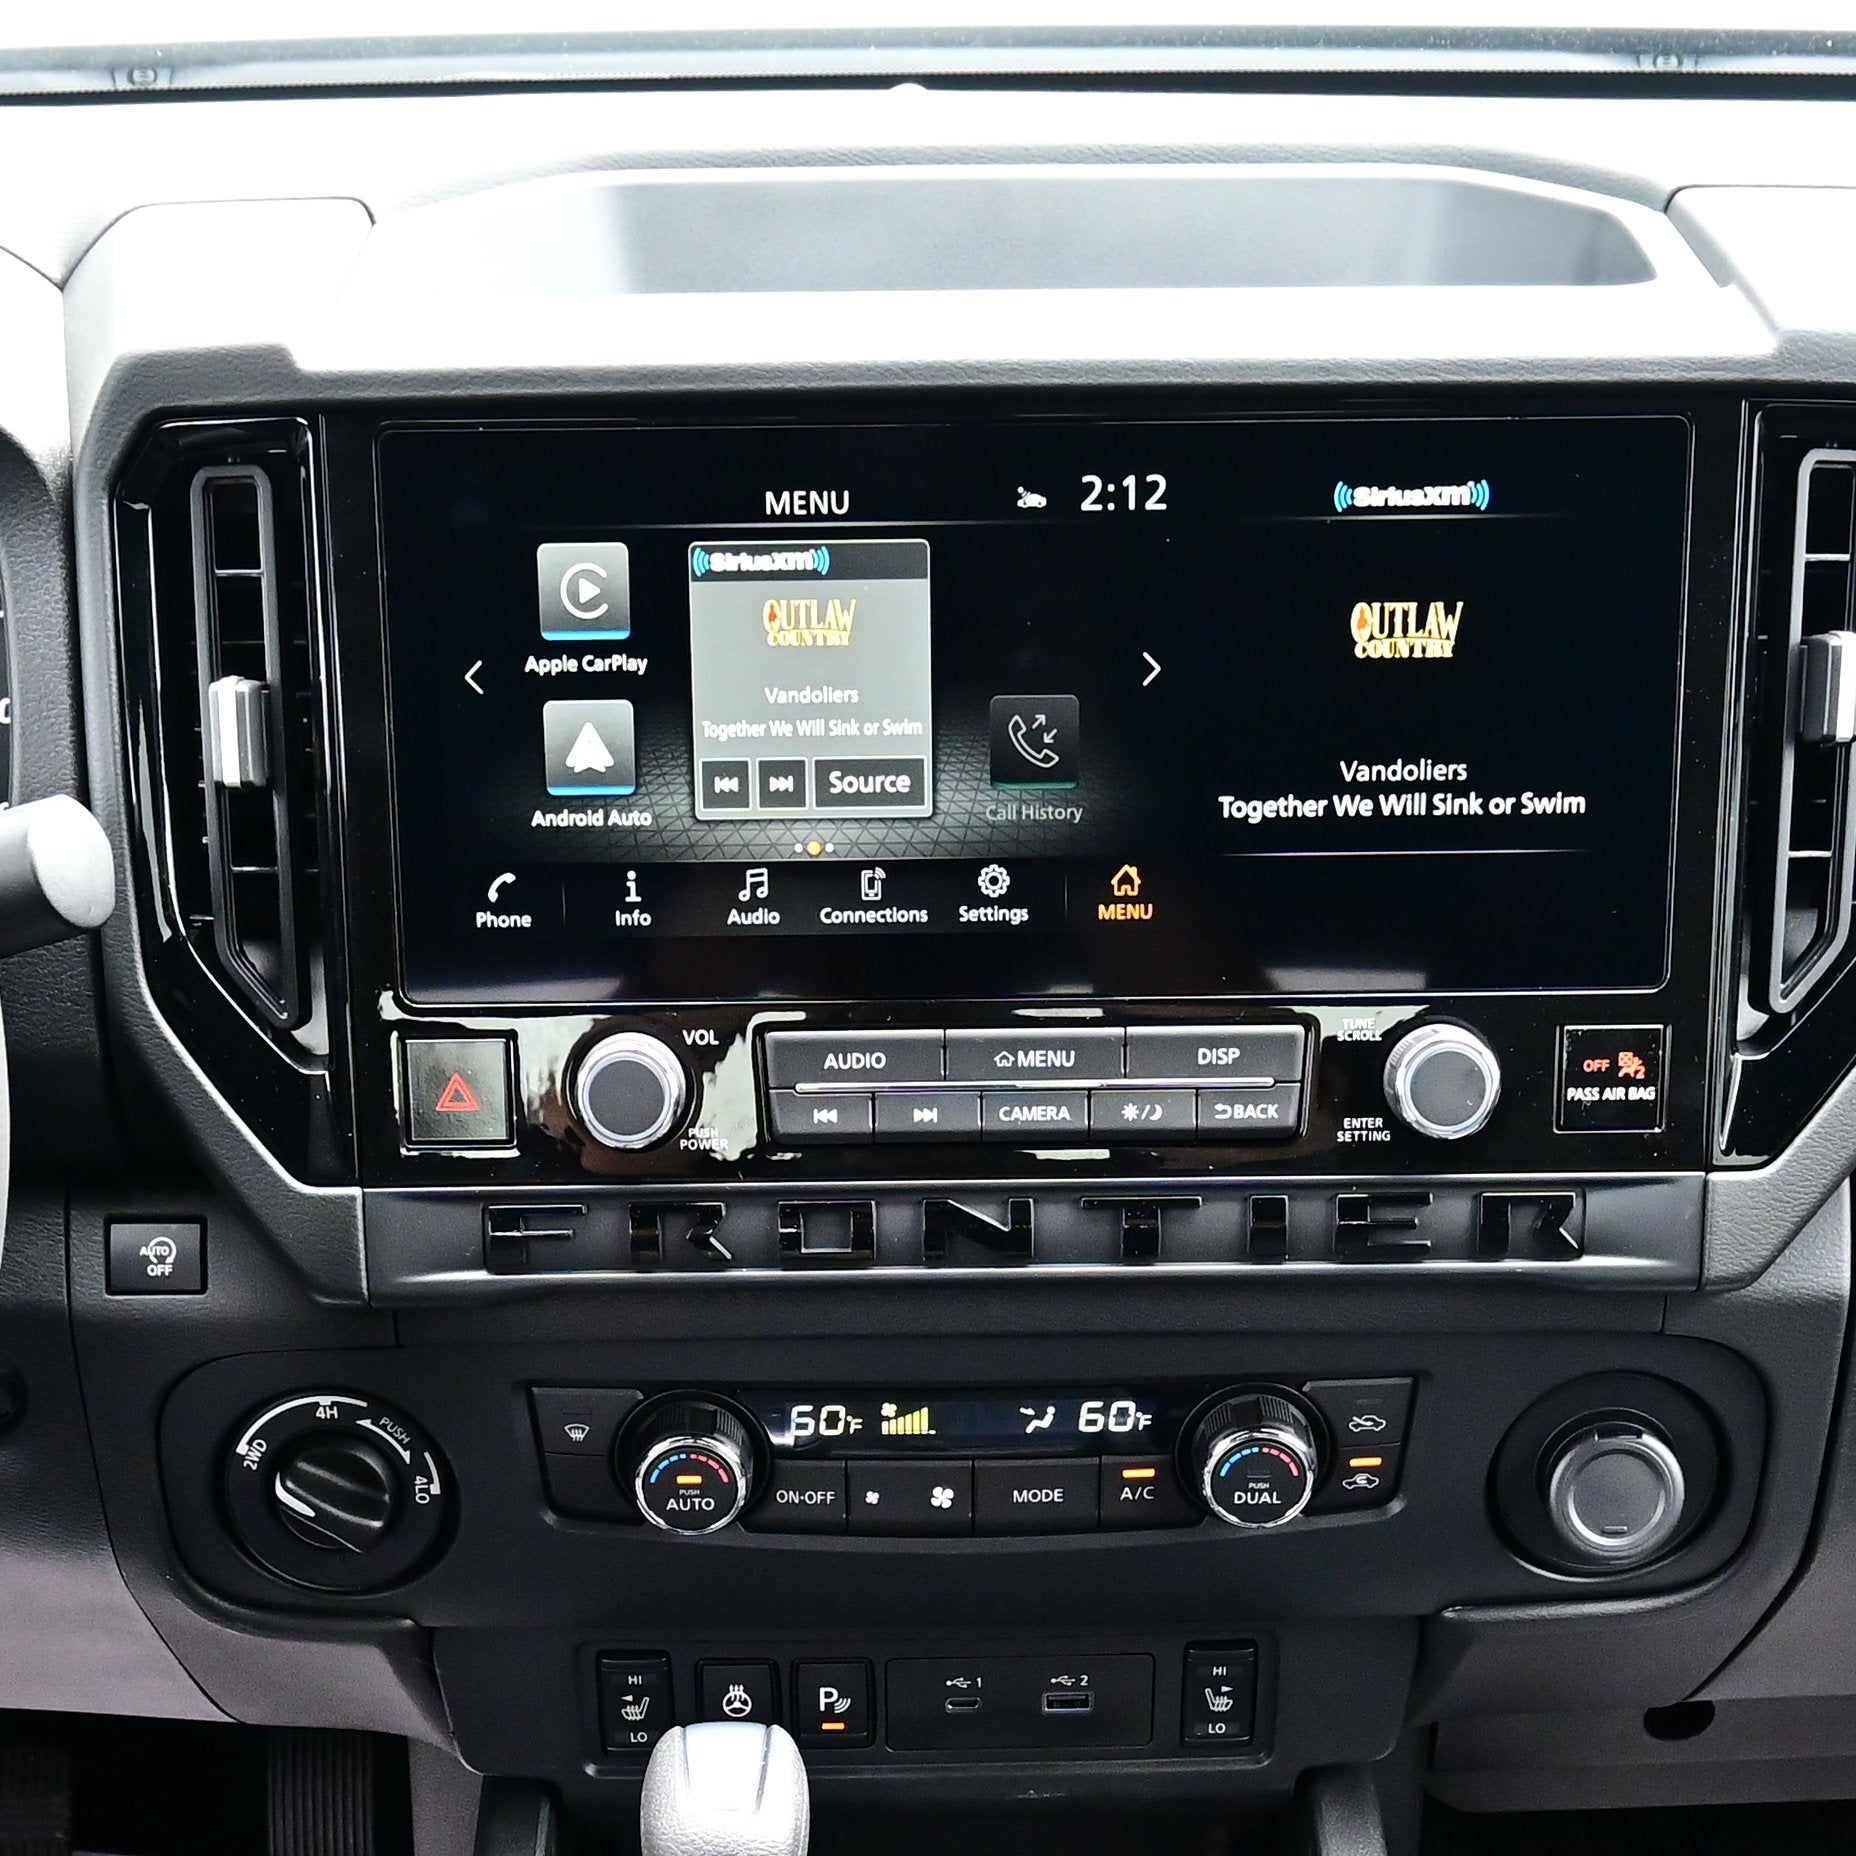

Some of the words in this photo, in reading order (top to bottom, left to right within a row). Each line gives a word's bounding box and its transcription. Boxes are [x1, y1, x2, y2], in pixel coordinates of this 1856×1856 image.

[1080, 474, 1168, 512] 2:12
[765, 490, 850, 515] MENU
[763, 598, 857, 632] OUTLAW
[1350, 601, 1464, 640] OUTLAW
[767, 630, 852, 647] COUNTRY
[1354, 638, 1455, 659] COUNTRY
[524, 654, 578, 676] Apple
[581, 654, 648, 675] CarPlay
[764, 686, 859, 704] Vandoliers
[702, 720, 766, 740] Together
[768, 720, 793, 737] We
[796, 719, 825, 737] Will
[828, 718, 860, 736] Sink
[863, 722, 879, 736] or
[882, 719, 924, 736] Swim
[1339, 760, 1468, 783] Vandoliers
[829, 770, 911, 793] Source
[985, 804, 1015, 821] Call
[1022, 803, 1083, 825] History
[1218, 796, 1328, 824] Together
[1332, 795, 1373, 818] We
[1379, 794, 1427, 817] Will
[1432, 793, 1484, 817] Sink
[1489, 799, 1516, 816] or
[1520, 792, 1587, 816] Swim
[531, 809, 604, 827] Android
[607, 809, 653, 826] Auto
[475, 909, 532, 929] Phone
[615, 908, 652, 928] Info
[727, 907, 781, 926] Audio
[819, 906, 929, 925] Connections
[958, 904, 1030, 926] Settings
[1097, 903, 1154, 922] MENU
[1342, 1018, 1376, 1031] TUNE
[682, 1029, 720, 1046] VOL
[1336, 1029, 1382, 1042] SCROLL
[824, 1052, 887, 1070] AUDIO
[1016, 1050, 1076, 1068] MENU
[1197, 1048, 1241, 1066] DISP
[1582, 1059, 1610, 1073] OFF
[1566, 1087, 1601, 1102] PASS
[1602, 1086, 1626, 1101] AIR
[1627, 1085, 1656, 1101] BAG
[999, 1105, 1070, 1122] CAMERA
[1234, 1103, 1280, 1120] BACK
[1343, 1117, 1384, 1130] ENTER
[688, 1127, 720, 1139] PUSH
[1336, 1129, 1391, 1143] SETTING
[679, 1138, 729, 1151] POWER
[484, 1193, 1588, 1266] FRONTIER
[139, 1245, 170, 1257] AUTO
[147, 1264, 173, 1277] OFF
[315, 1406, 339, 1420] 4H
[378, 1416, 412, 1446] PUSH
[243, 1438, 269, 1471] 2WD
[414, 1475, 431, 1505] 4LO
[1012, 1488, 1064, 1504] MODE
[1120, 1485, 1155, 1501] A/C
[1234, 1491, 1282, 1505] DUAL
[666, 1497, 715, 1512] AUTO
[627, 1674, 643, 1686] HI
[1079, 1674, 1089, 1686] 2
[1212, 1665, 1228, 1677] HI
[975, 1676, 982, 1688] 1
[629, 1731, 648, 1744] LO
[1208, 1723, 1226, 1735] LO
